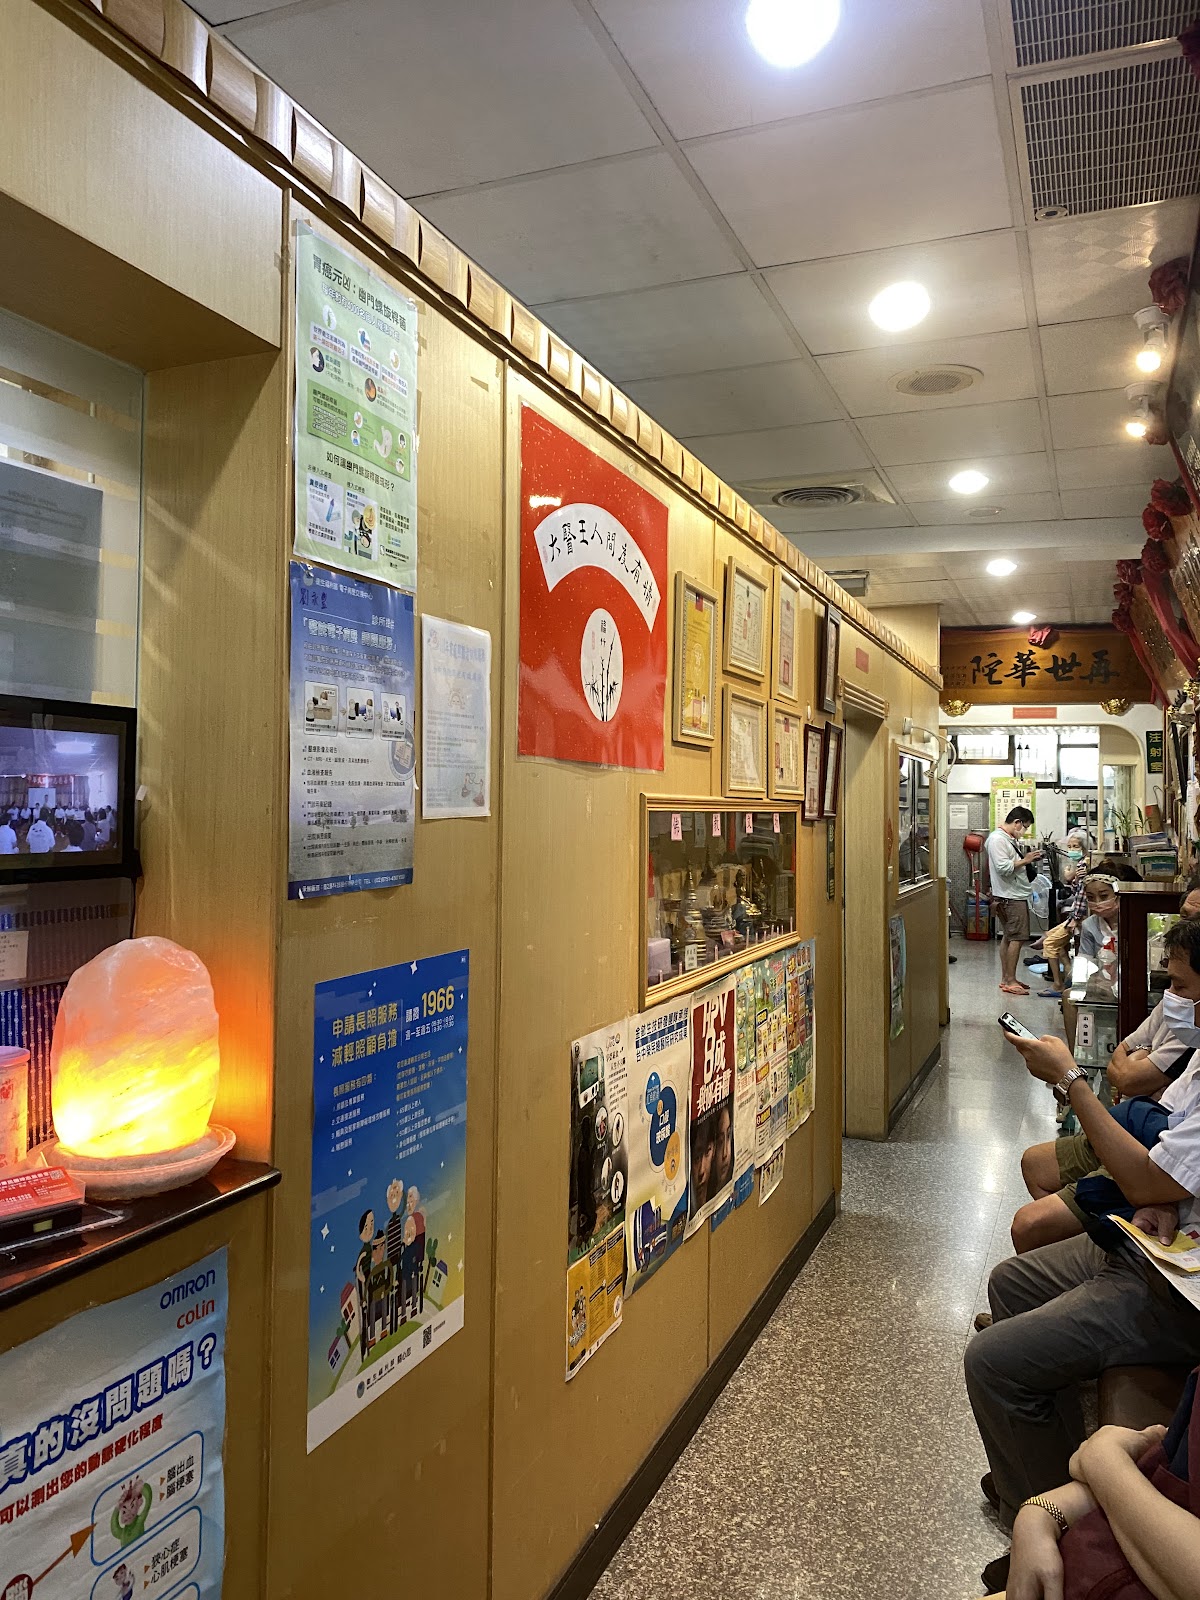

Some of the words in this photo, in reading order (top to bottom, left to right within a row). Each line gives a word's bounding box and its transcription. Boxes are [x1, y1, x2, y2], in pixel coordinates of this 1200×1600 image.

[1149, 732, 1163, 772] 注射室
[332, 1002, 398, 1038] 申請長照服務
[421, 985, 455, 1018] 1966
[701, 990, 729, 1038] HPV
[332, 1028, 398, 1067] 減輕照顧負擔
[405, 1022, 431, 1041] 週一至週五
[703, 1026, 727, 1086] 8成
[160, 1269, 216, 1310] OMRON
[176, 1299, 215, 1330] colin
[0, 1333, 216, 1492] 真的沒問題嗎？
[0, 1413, 164, 1526] 可以測出您的動脈硬化程度
[165, 1468, 195, 1500] 腦梗塞
[167, 1455, 195, 1482] 腦出血
[150, 1547, 189, 1585] 心肌梗塞
[151, 1538, 181, 1568] 狹心症
